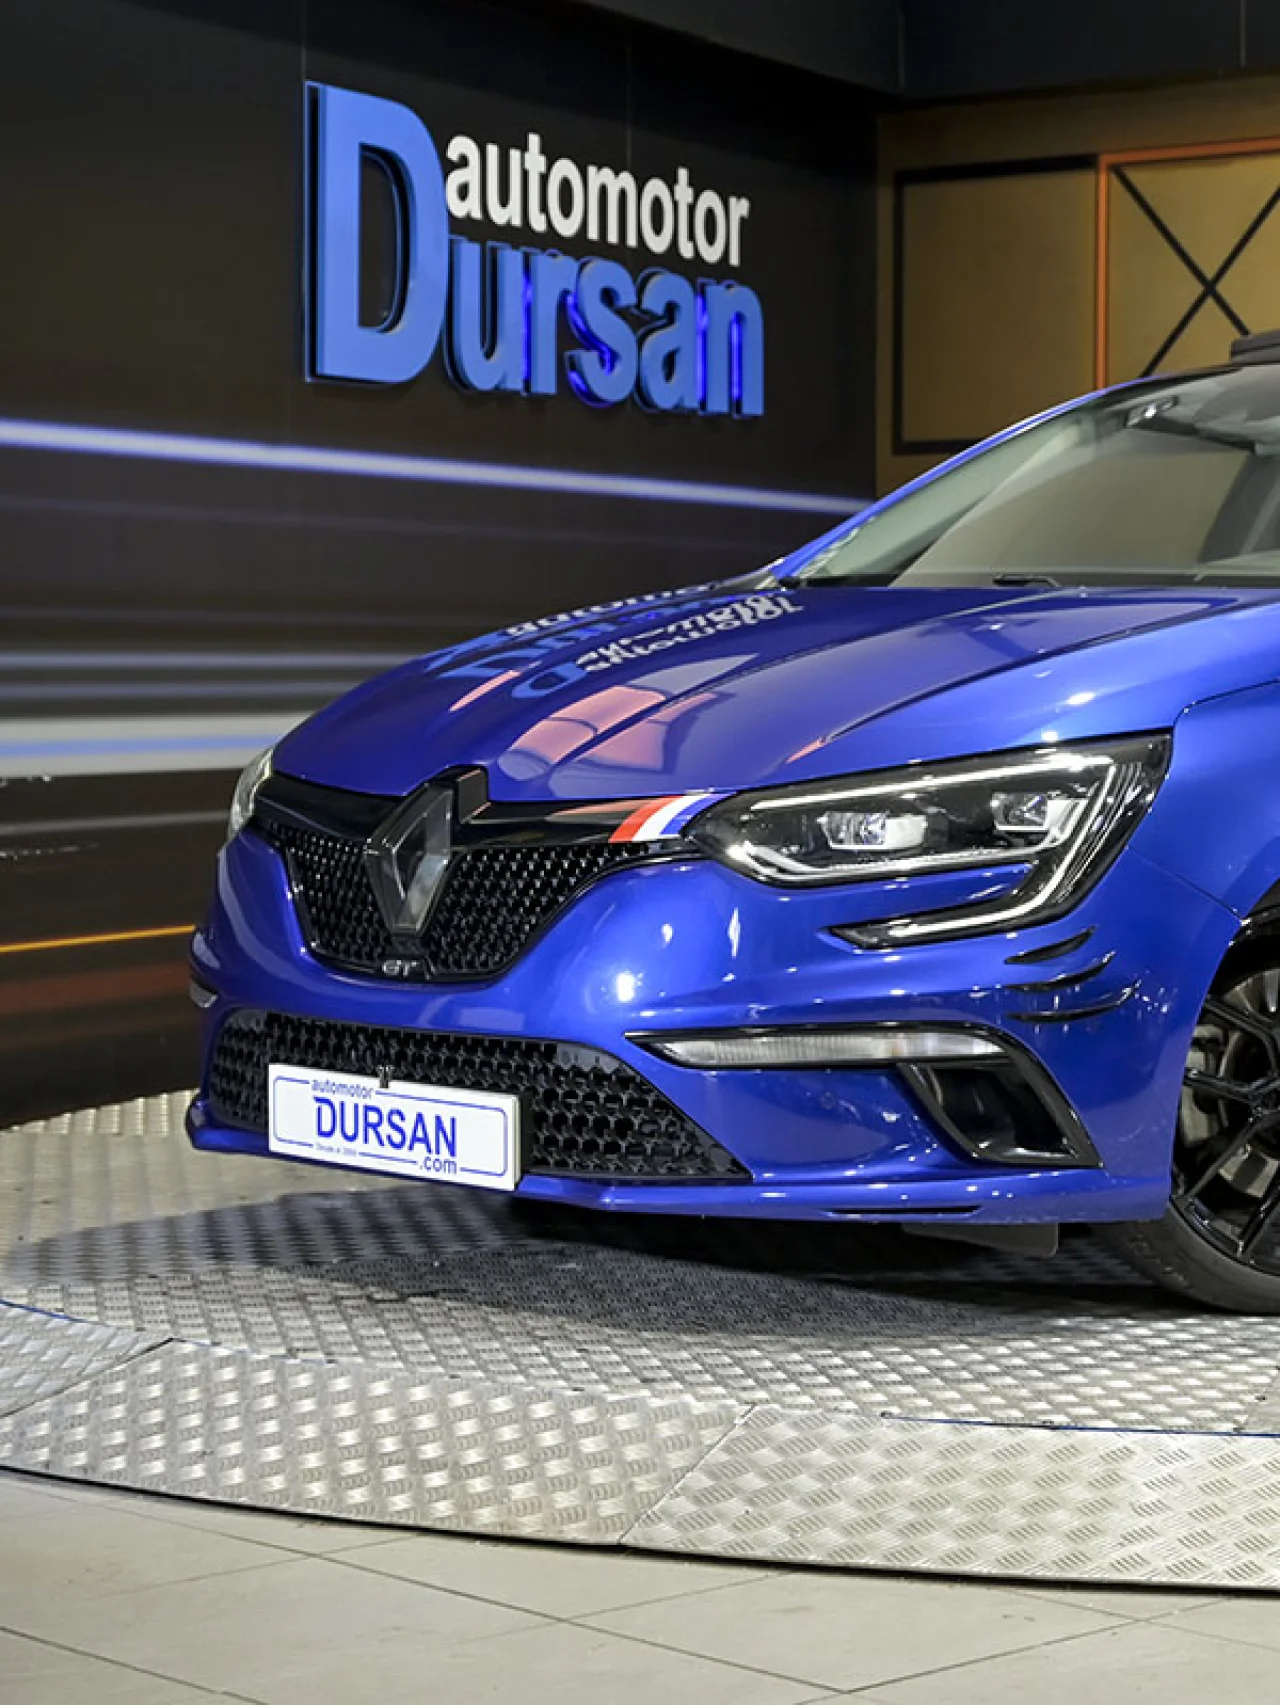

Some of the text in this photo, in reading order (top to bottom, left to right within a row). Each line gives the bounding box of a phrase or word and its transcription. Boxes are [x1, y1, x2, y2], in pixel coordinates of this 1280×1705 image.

[445, 132, 749, 267] automotor
[305, 80, 764, 418] Dursan
[382, 960, 419, 977] GT
[311, 1079, 374, 1100] automotor
[313, 1096, 457, 1158] DURSAN
[419, 1155, 458, 1175] .com
